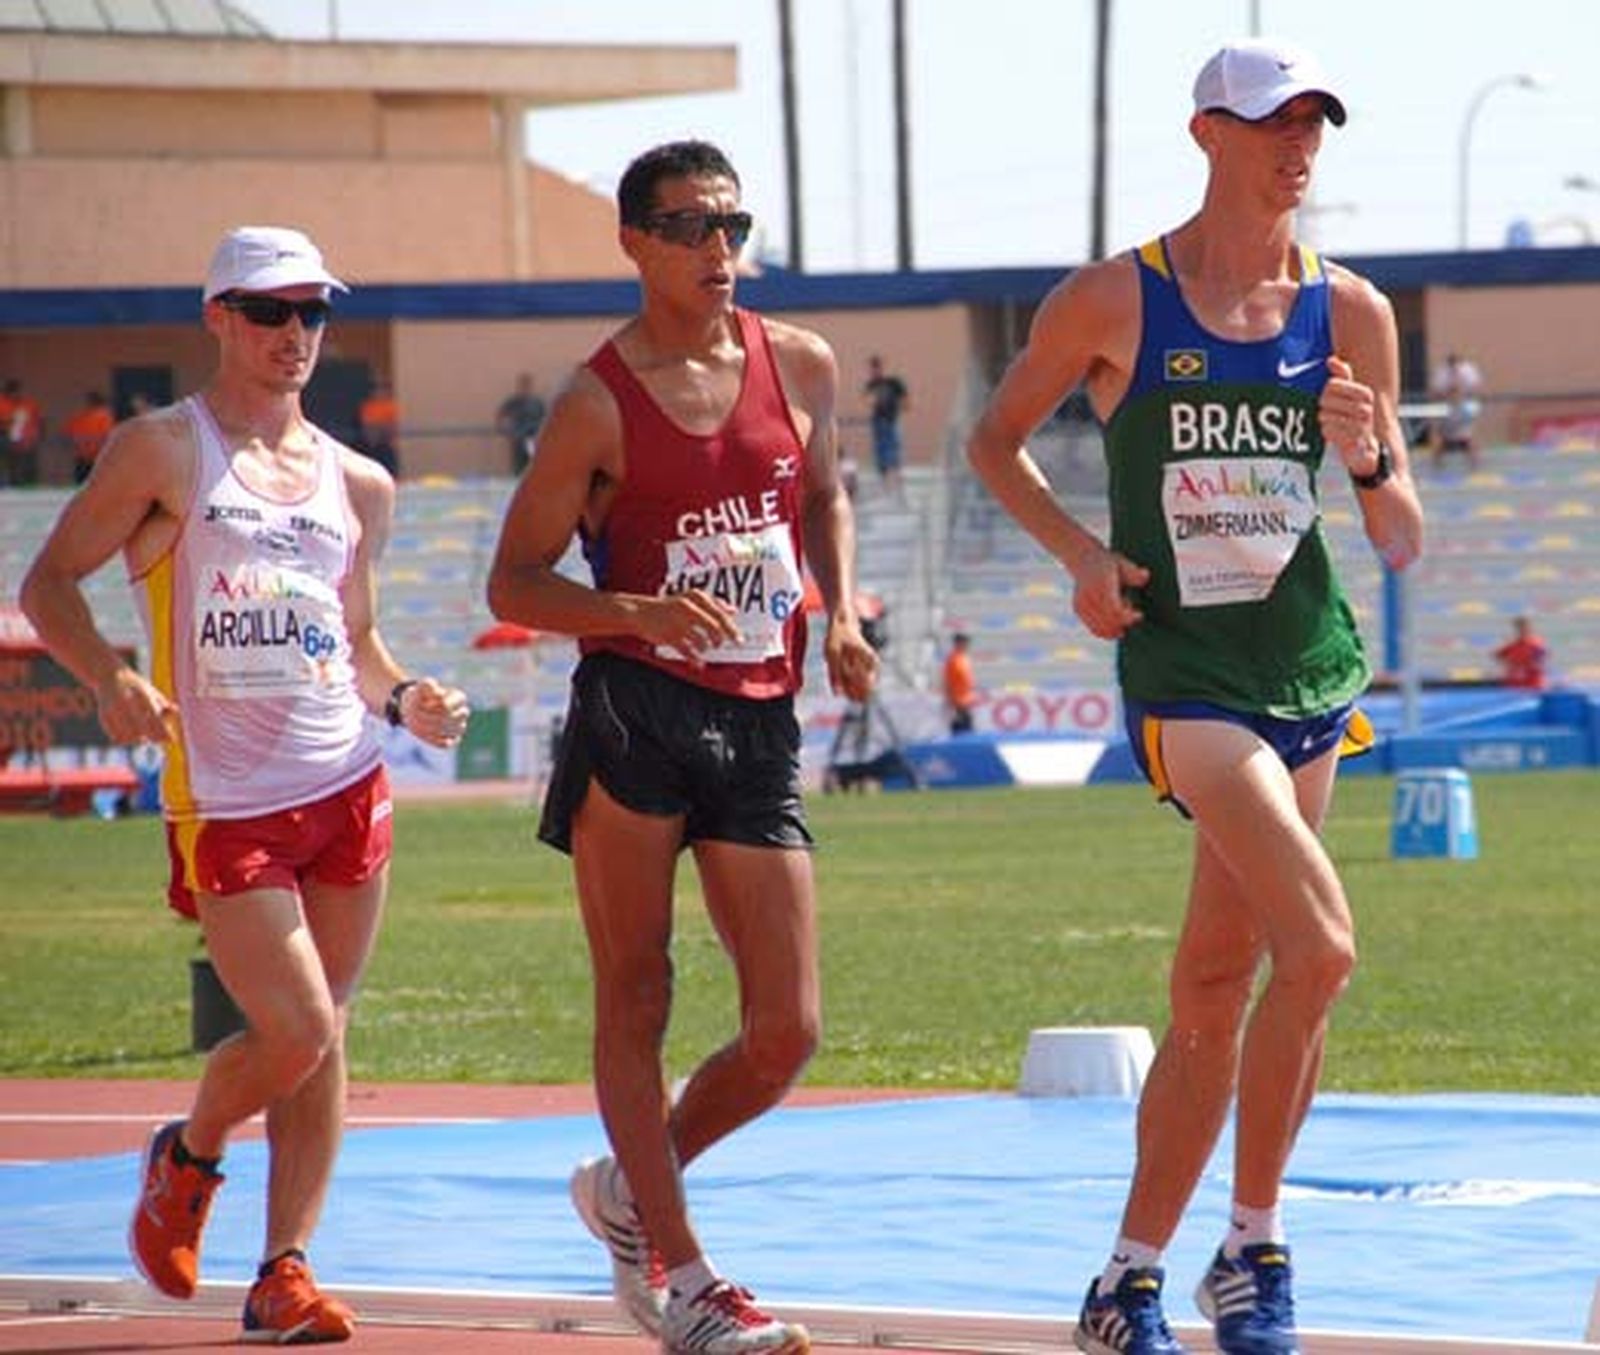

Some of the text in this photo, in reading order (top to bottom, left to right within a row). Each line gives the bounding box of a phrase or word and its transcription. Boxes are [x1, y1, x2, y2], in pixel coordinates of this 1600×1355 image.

[1170, 402, 1310, 453] BRASIL
[677, 489, 780, 538] CHILE
[1173, 511, 1287, 541] ZIMMERMANN
[200, 609, 301, 648] ARCILLA
[1399, 781, 1443, 825] 70
